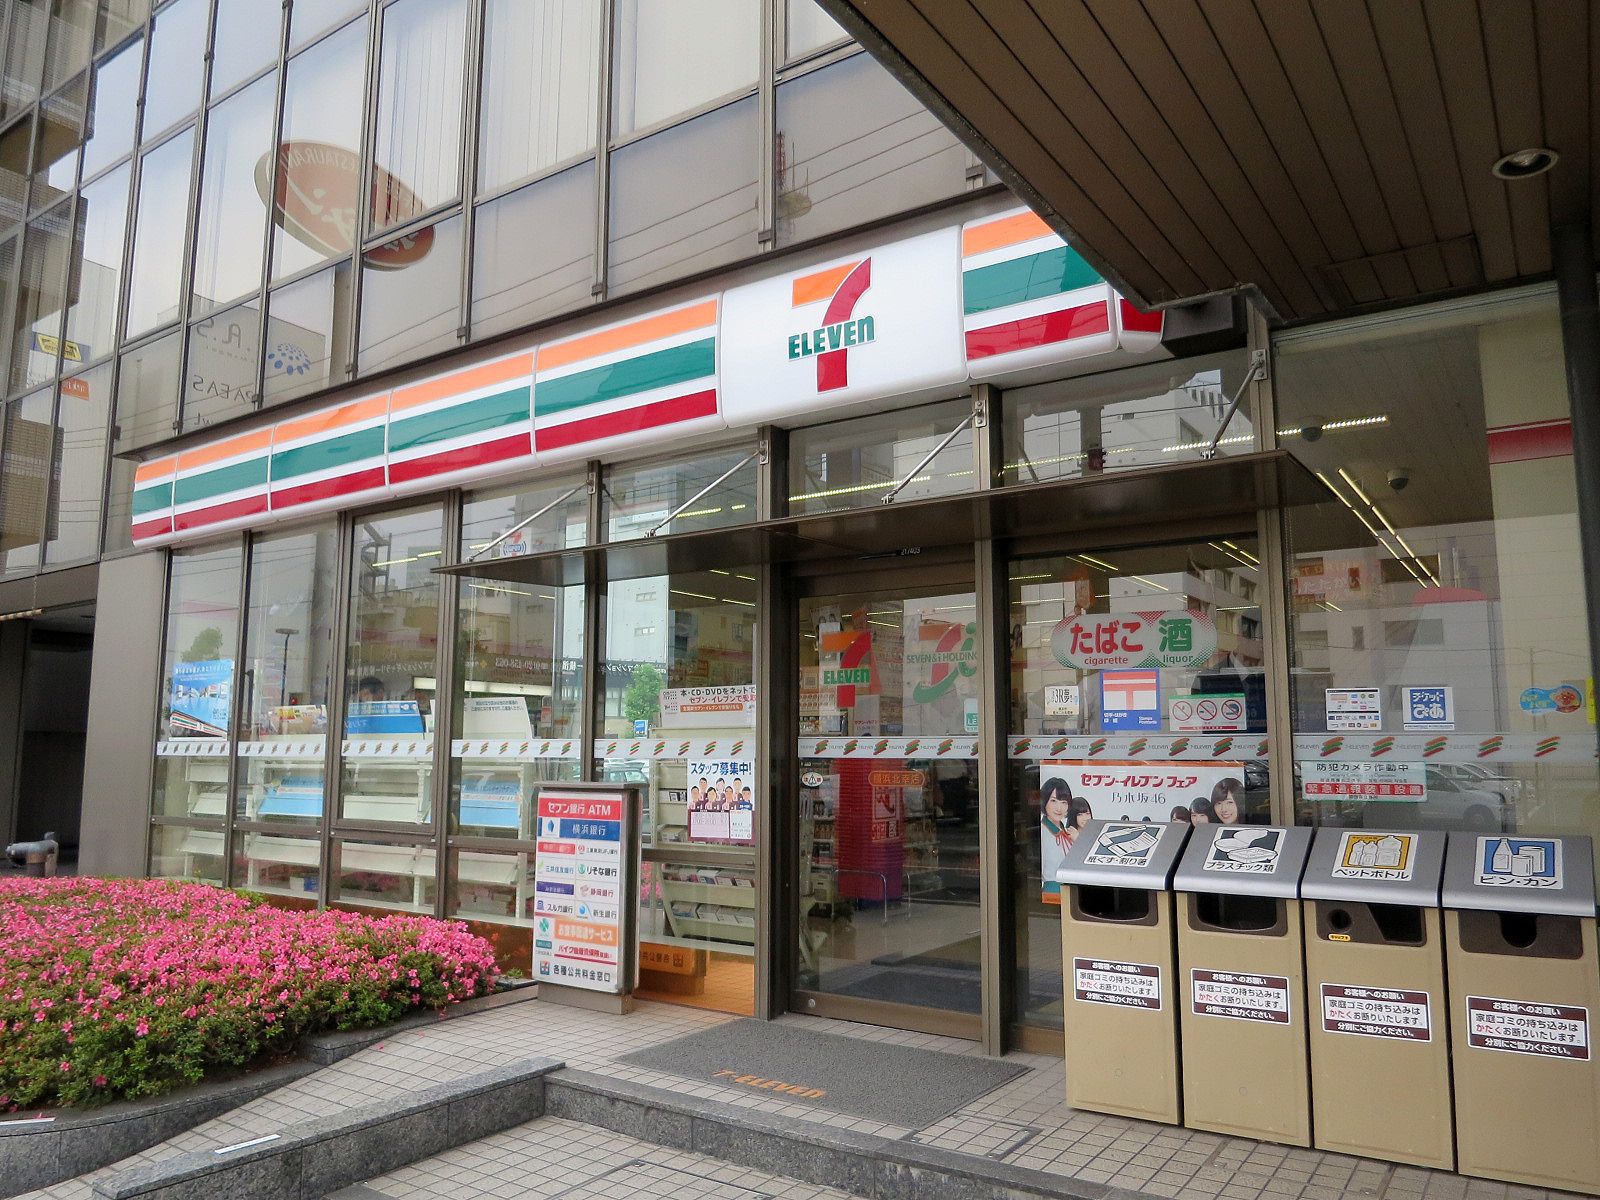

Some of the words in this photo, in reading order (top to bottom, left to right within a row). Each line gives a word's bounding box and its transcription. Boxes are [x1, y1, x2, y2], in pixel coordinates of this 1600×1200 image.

[1070, 620, 1143, 655] たばこ
[1159, 618, 1192, 652] 酒
[1084, 656, 1128, 665] cigarette
[1163, 654, 1193, 664] liquor
[1413, 703, 1445, 719] ぴあ
[690, 762, 752, 776] スタッフ募集中!
[1316, 763, 1409, 772] 防犯カメラ作動中
[1166, 775, 1198, 789] フェア
[1112, 791, 1166, 805] 乃木坂46
[548, 801, 585, 815] セブン銀行
[588, 804, 611, 816] ATM
[572, 824, 606, 836] 横浜銀行
[586, 866, 617, 877] りそな銀行
[1206, 861, 1275, 873] プラスチック類
[1334, 867, 1410, 880] ペットボトル
[1479, 875, 1558, 887] ビン・カン
[547, 903, 573, 914] スルガ銀行
[593, 909, 617, 920] 新生銀行
[553, 964, 611, 983] 各種公共料金窓口
[1092, 962, 1141, 973] お客様へのお願い
[1079, 972, 1153, 986] 家庭ゴミの持ち込みは
[1212, 973, 1267, 985] お客様へのお願い
[1079, 980, 1155, 996] かたくお断りいたします。
[1198, 983, 1281, 999] 家庭ゴミの持ち込みは
[1343, 988, 1405, 1000] お客様へのお願い
[1085, 991, 1148, 1007] 分別にご協力ください。
[1198, 993, 1283, 1010] かたくお断りいたします。
[1205, 1005, 1275, 1020] 分別にご協力ください。
[1329, 999, 1421, 1016] 家庭ゴミの持ち込みは
[1492, 1001, 1561, 1016] お客様へのお願い
[1329, 1009, 1423, 1026] かたくお断りいたします。
[1475, 1013, 1578, 1032] 家庭ゴミの持ち込みは
[1337, 1021, 1414, 1037] 分別にご協力ください。
[1475, 1023, 1581, 1044] かたくお断りいたします。
[1484, 1037, 1571, 1055] 分別にご協力ください。
